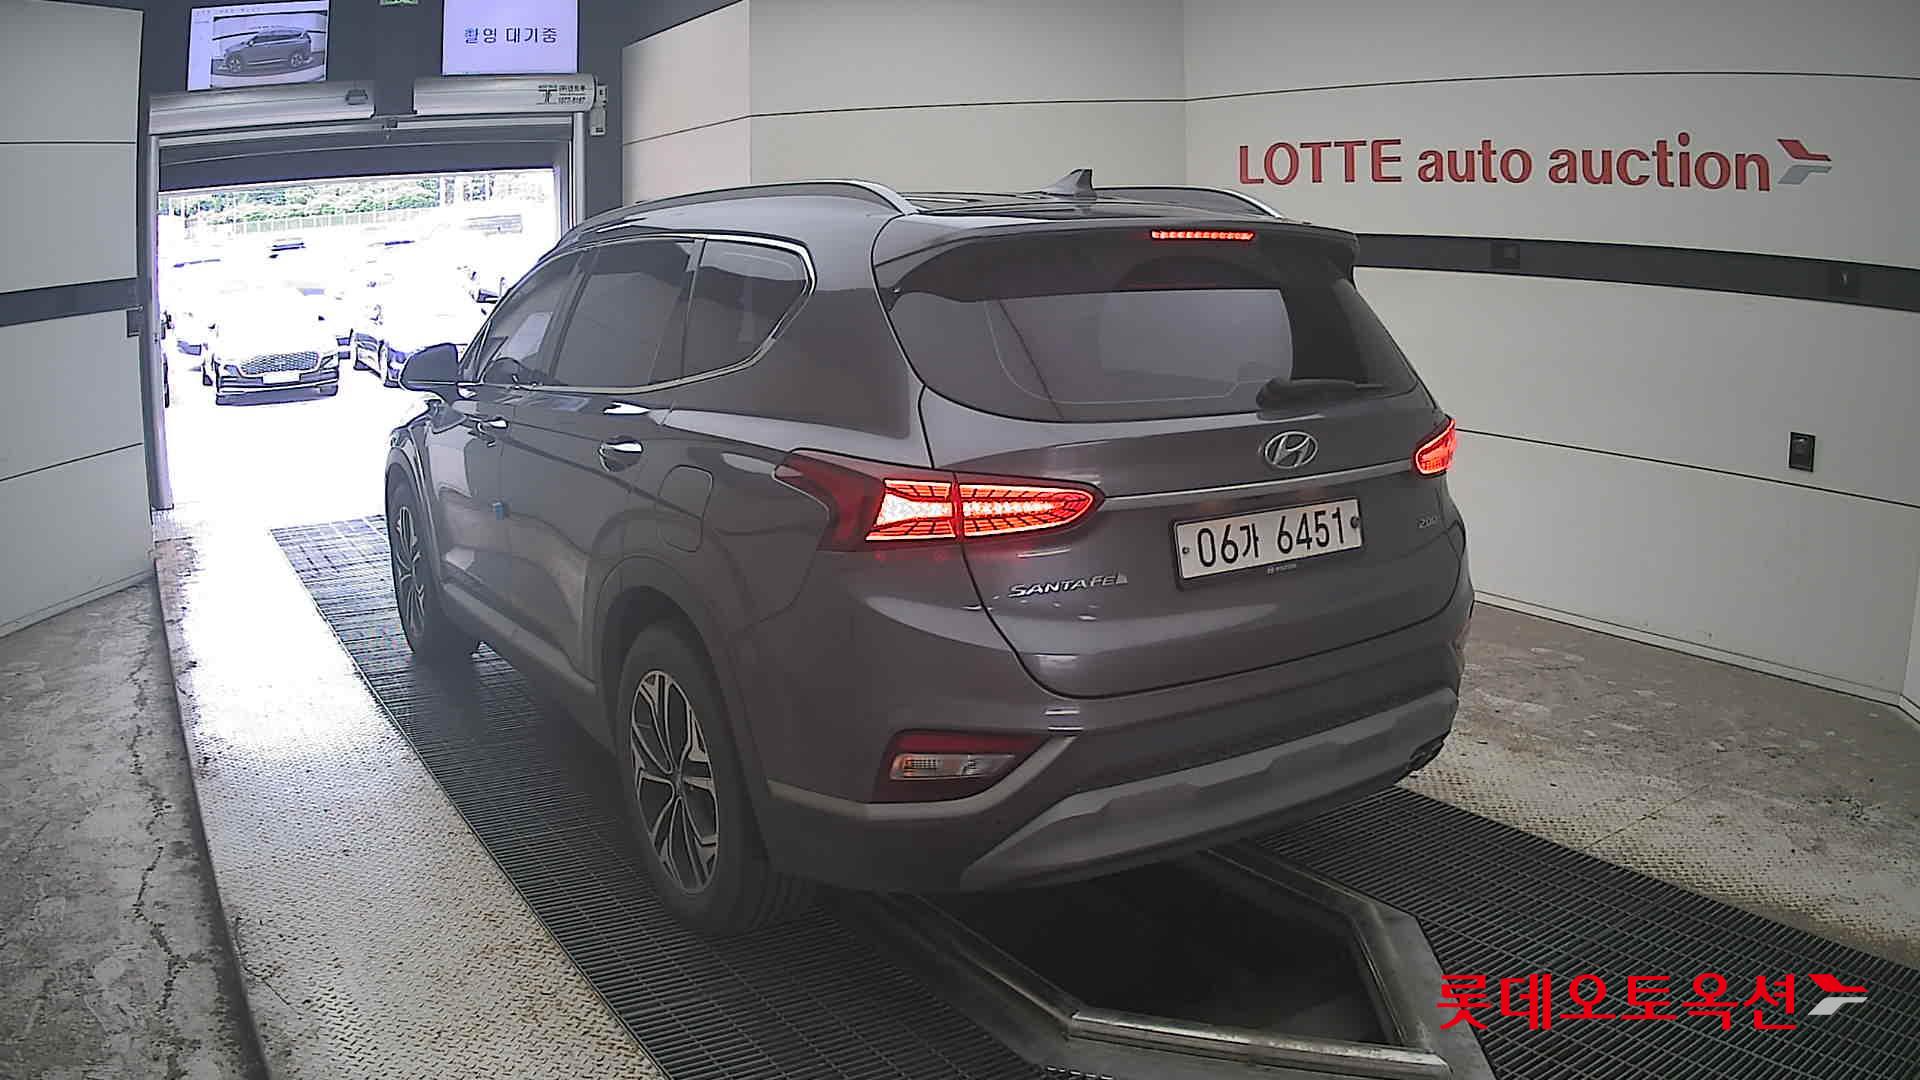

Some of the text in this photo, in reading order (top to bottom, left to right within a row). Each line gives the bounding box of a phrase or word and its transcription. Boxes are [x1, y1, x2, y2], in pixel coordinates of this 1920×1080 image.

[505, 26, 558, 44] 대기중
[1239, 132, 1771, 192] LOTTE auto auction
[1197, 506, 1344, 568] 06가 6451
